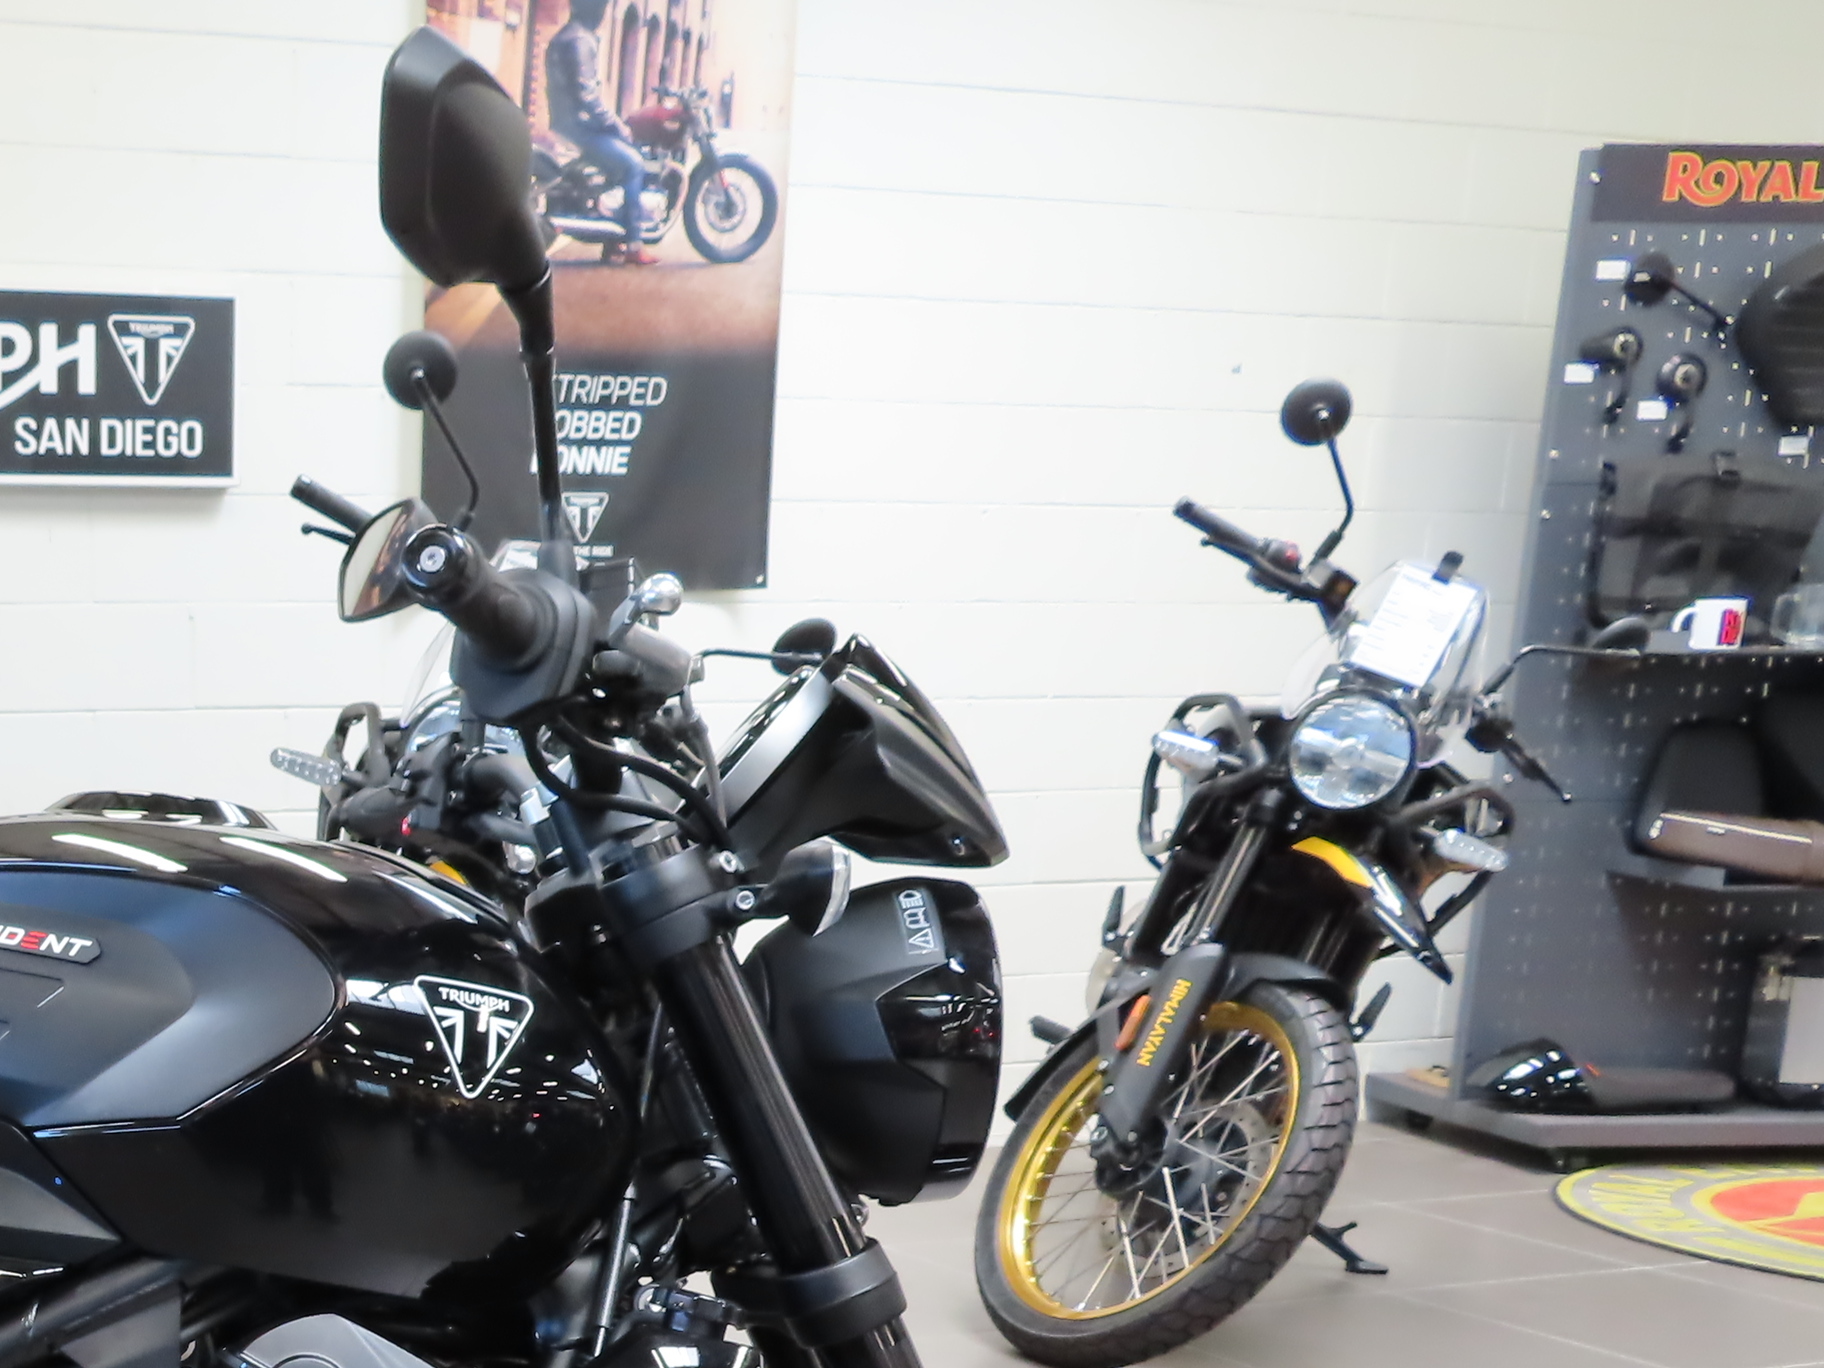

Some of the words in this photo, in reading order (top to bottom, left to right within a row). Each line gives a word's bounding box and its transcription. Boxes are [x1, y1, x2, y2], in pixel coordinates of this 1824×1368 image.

[1662, 151, 1824, 208] ROYAL
[552, 373, 668, 406] TRIPPED
[14, 416, 90, 456] SAN
[100, 419, 203, 458] DIEGO
[555, 409, 643, 441] OBBED
[437, 986, 511, 1014] TRIUMPH
[1138, 979, 1192, 1066] HIMALAYAN
